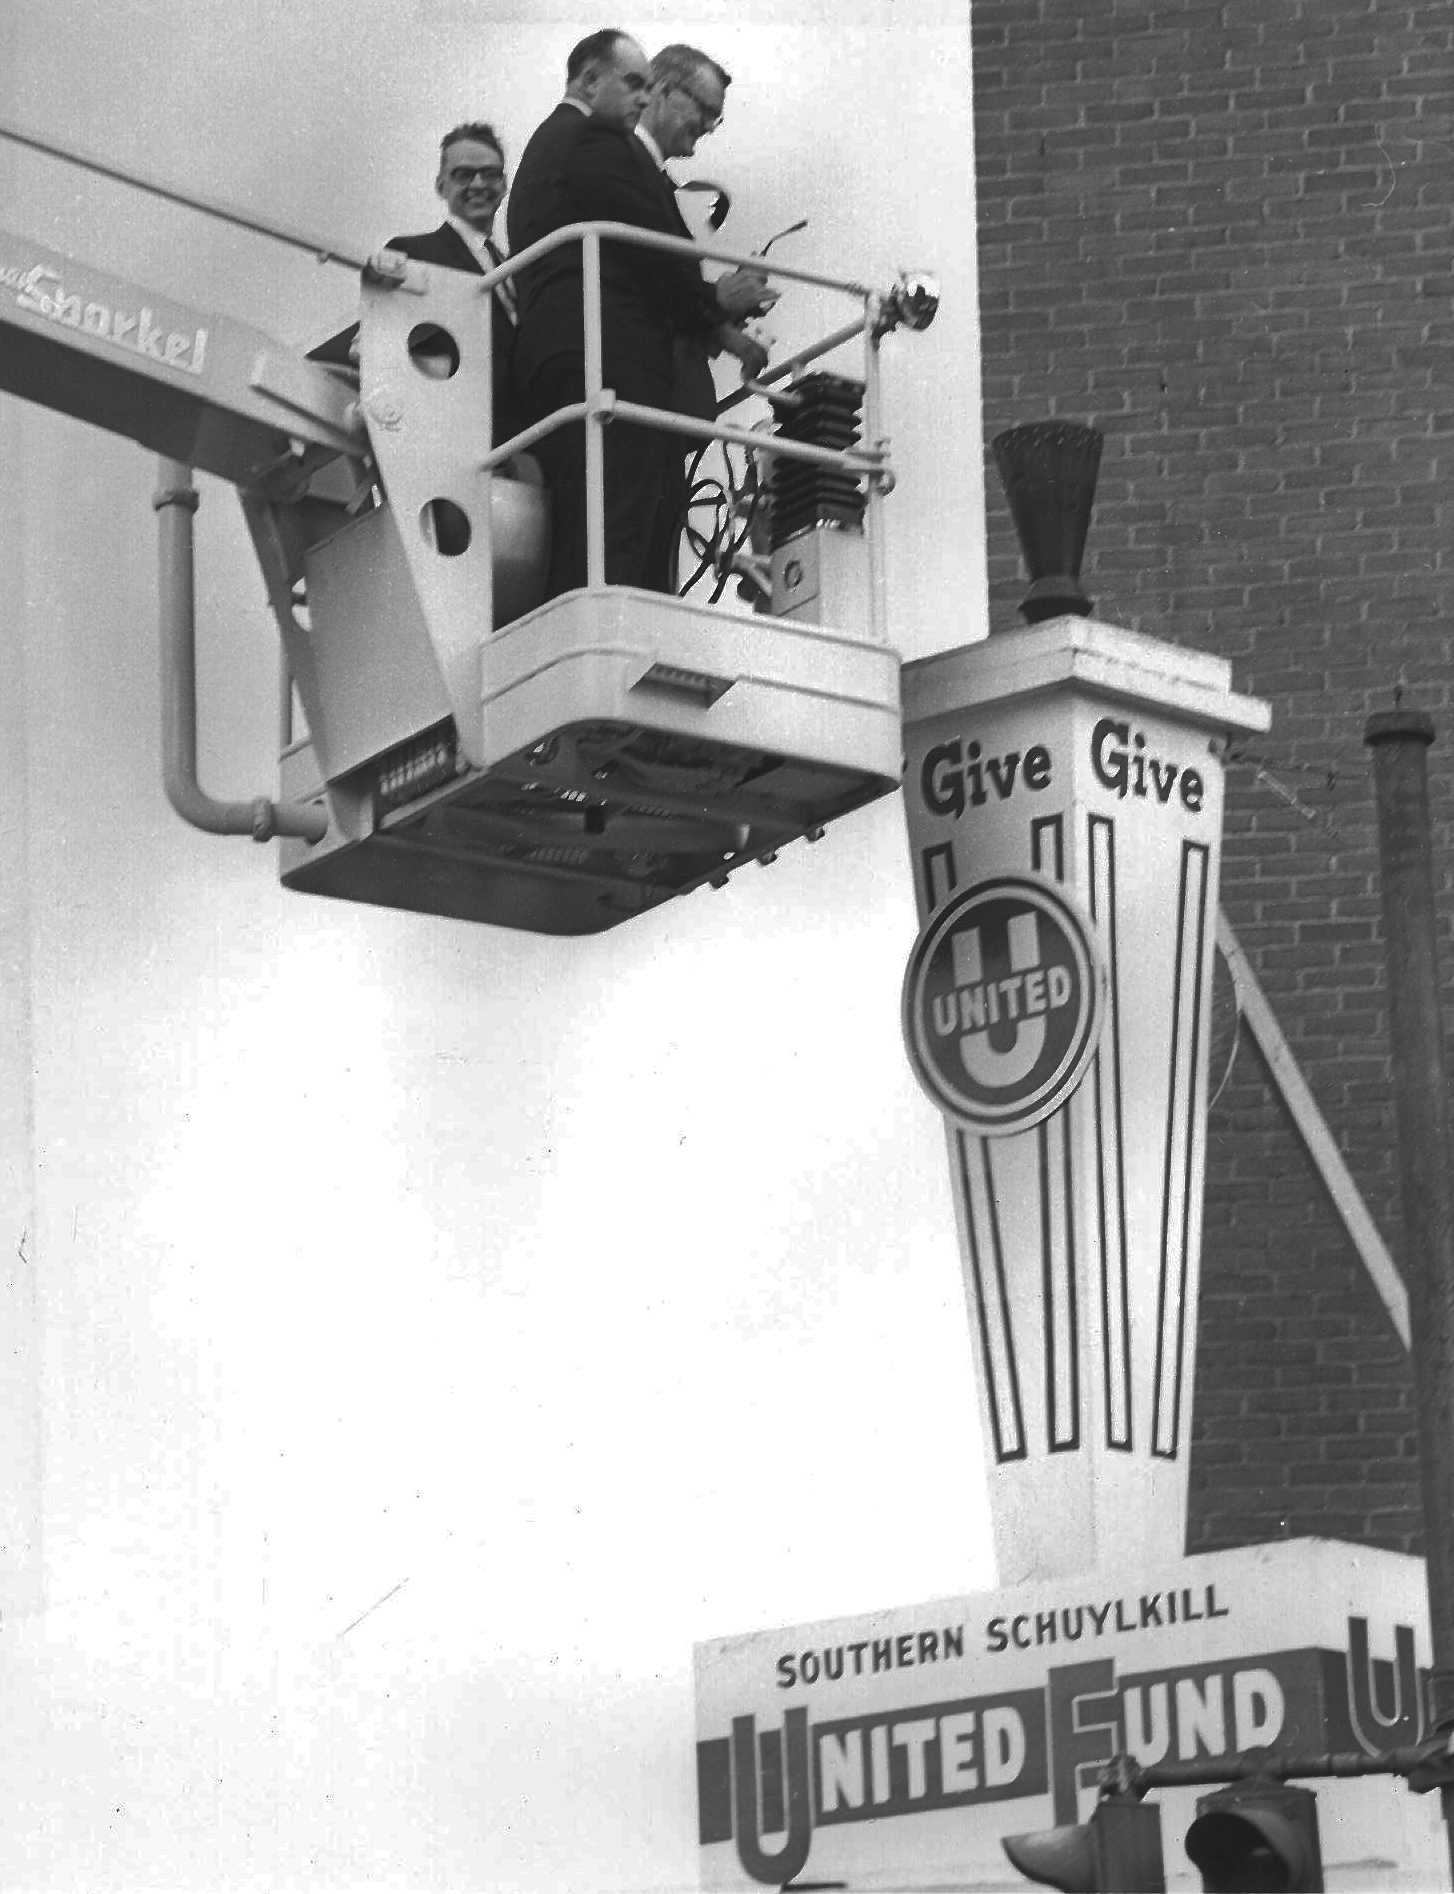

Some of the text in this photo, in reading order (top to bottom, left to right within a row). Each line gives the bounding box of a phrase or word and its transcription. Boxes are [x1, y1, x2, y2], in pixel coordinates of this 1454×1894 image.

[15, 264, 209, 375] Snorkel
[921, 739, 1052, 819] Give
[1090, 717, 1204, 812] Give
[932, 964, 1073, 1037] UNITED
[776, 1583, 1230, 1688] SOUTHERN SCHUYLKILL
[730, 1657, 1285, 1886] UNITED FUND
